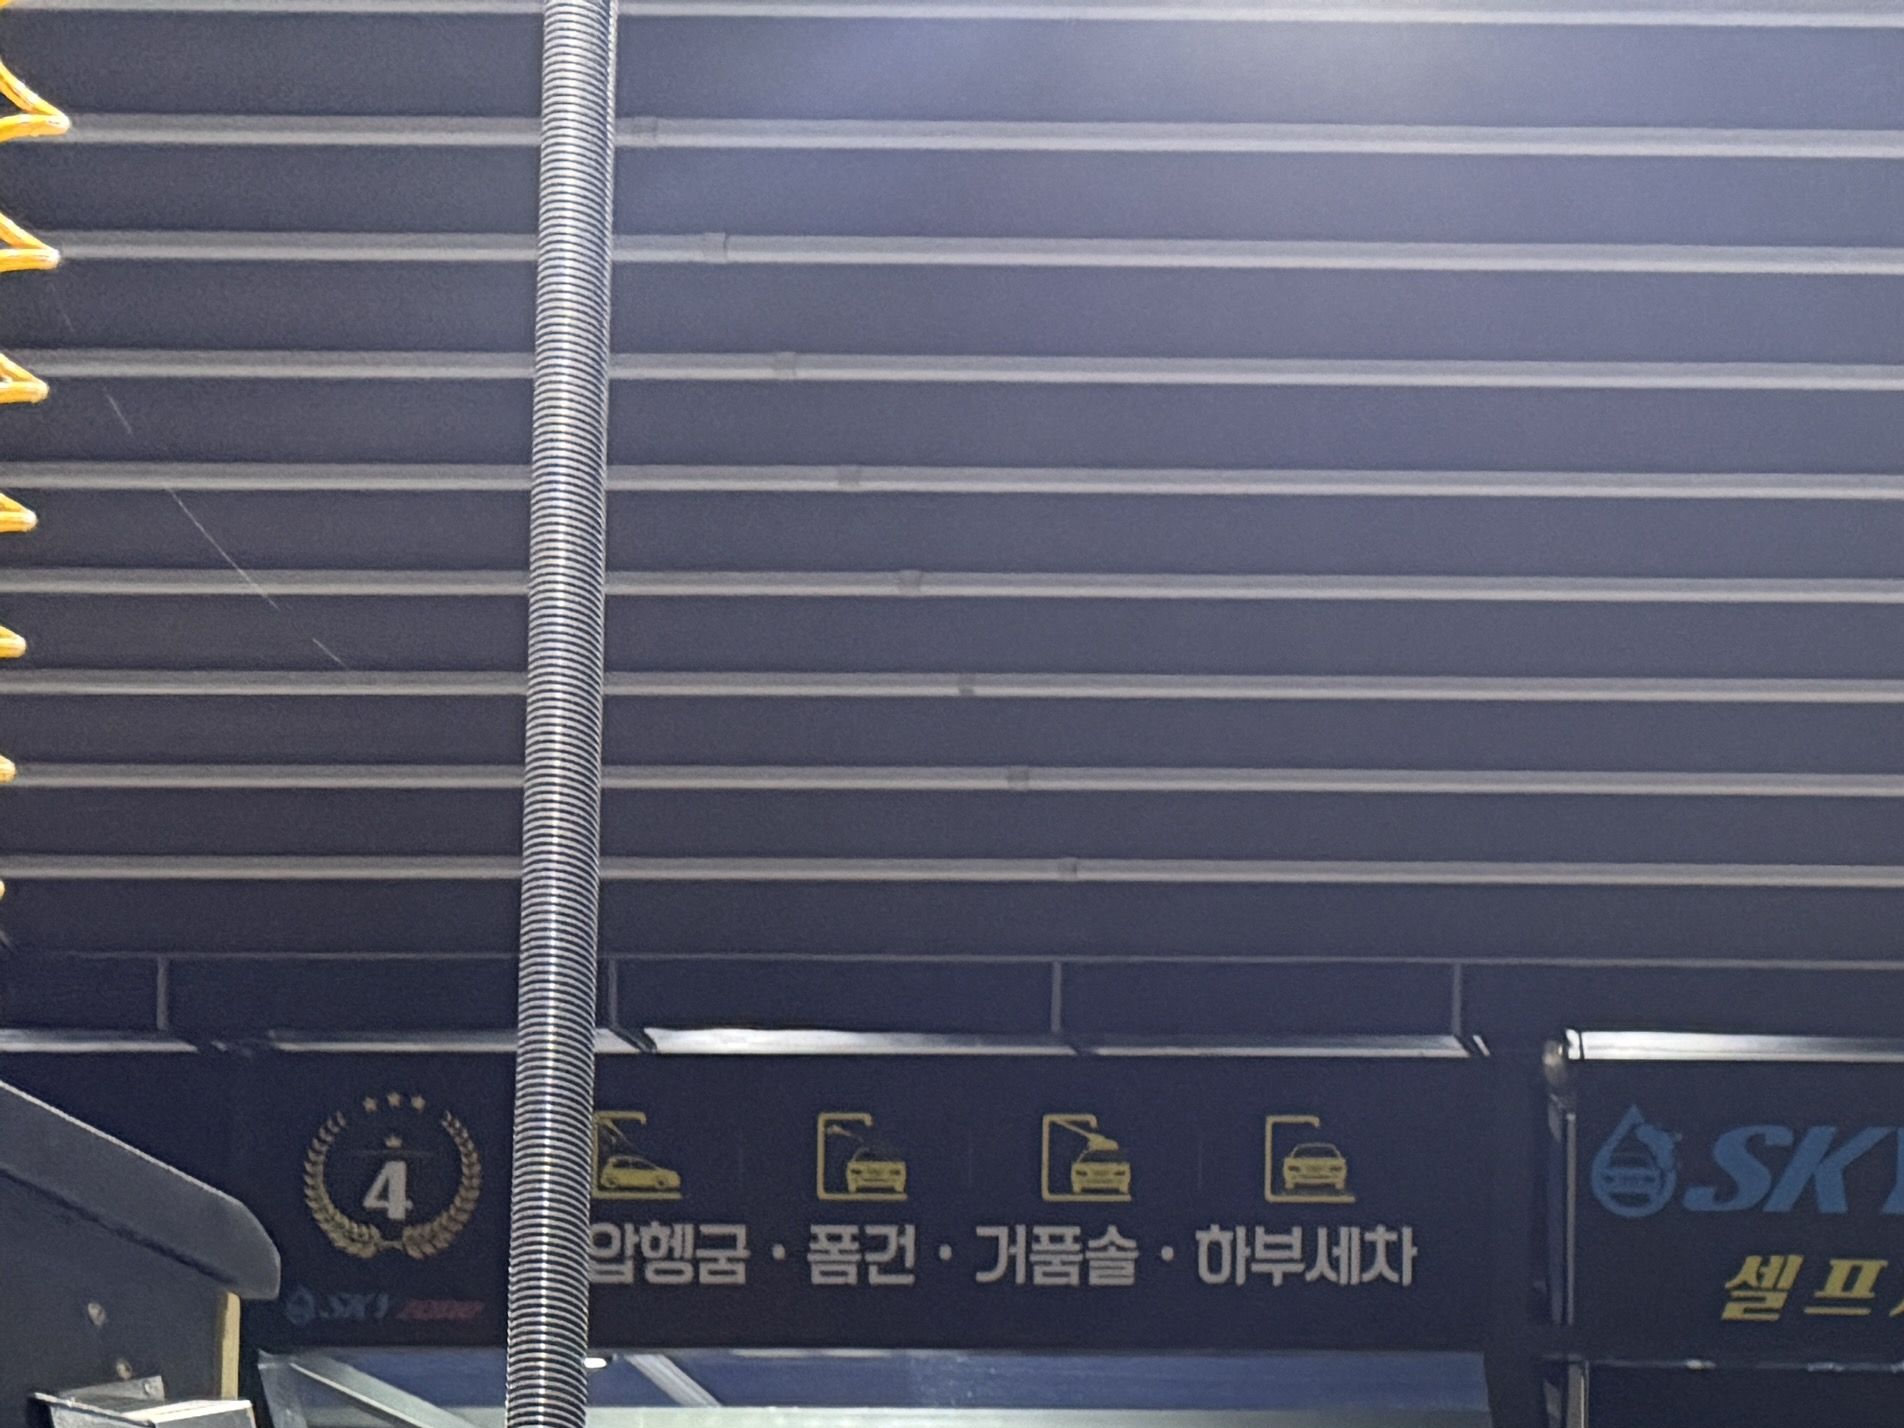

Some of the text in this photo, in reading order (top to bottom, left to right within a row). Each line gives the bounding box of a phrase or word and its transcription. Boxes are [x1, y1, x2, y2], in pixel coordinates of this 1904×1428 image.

[364, 1161, 412, 1220] 4
[588, 1221, 1417, 1286] 압헹굼 폼건 거품솔 하부세차
